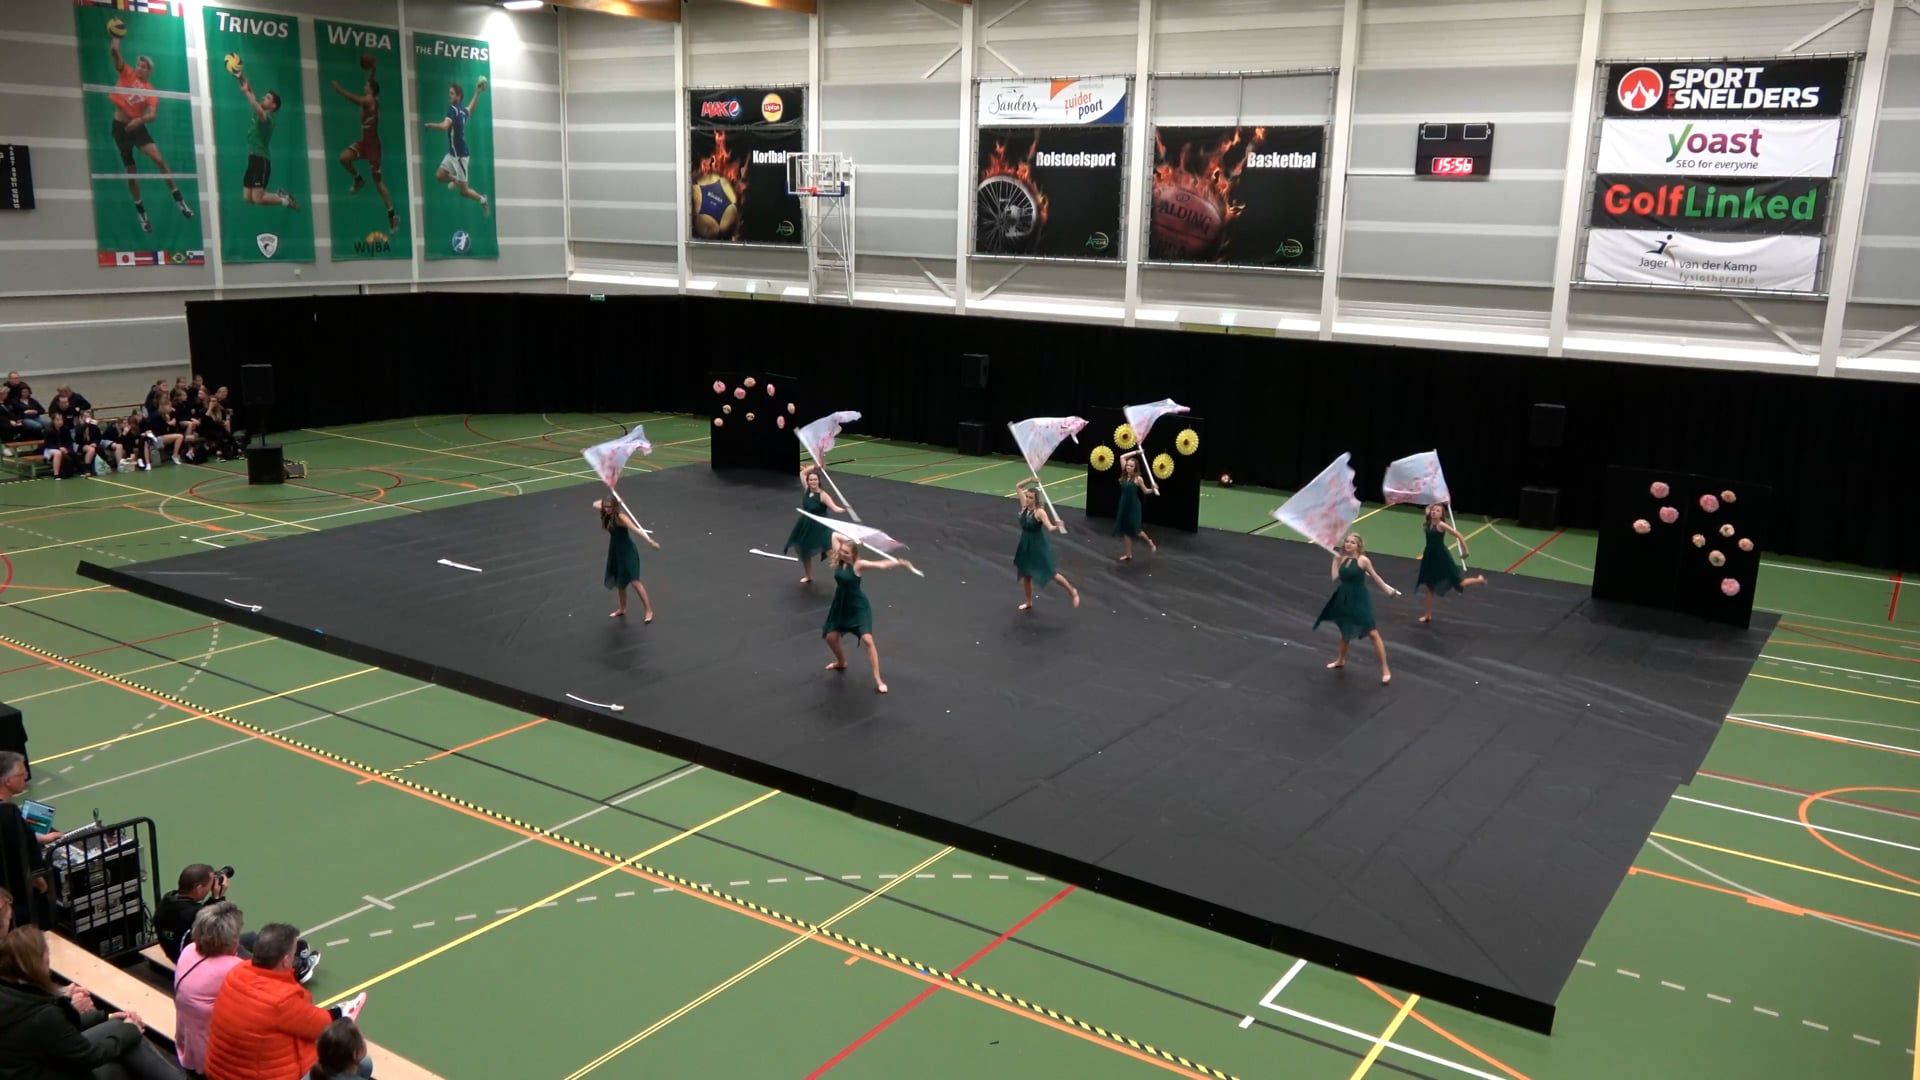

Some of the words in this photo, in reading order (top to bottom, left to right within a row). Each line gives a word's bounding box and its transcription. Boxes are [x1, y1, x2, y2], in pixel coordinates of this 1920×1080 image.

[216, 11, 289, 39] TRIVOS
[327, 24, 391, 50] WYBA
[415, 45, 432, 55] THE
[434, 40, 489, 61] FLYERS
[1669, 66, 1764, 89] SPORT
[988, 93, 1038, 115] Sanders
[1064, 91, 1092, 110] zuider
[1673, 86, 1820, 109] SNELDERS
[701, 101, 729, 118] MAX
[1078, 98, 1103, 121] poort
[1665, 123, 1763, 163] yoast
[752, 150, 786, 164] Korfbal
[1036, 151, 1117, 168] Rolstoelsport
[1247, 152, 1317, 168] Basketbal
[1437, 158, 1472, 172] 15:56
[1675, 159, 1695, 168] SEO
[1698, 159, 1712, 168] for
[1714, 160, 1759, 170] everyone
[1604, 183, 1818, 220] GolfLinked
[1638, 256, 1667, 270] Jager
[1679, 260, 1699, 270] van
[1701, 259, 1721, 271] der
[1723, 260, 1757, 273] Kamp
[1679, 271, 1756, 285] fysiotherapie
